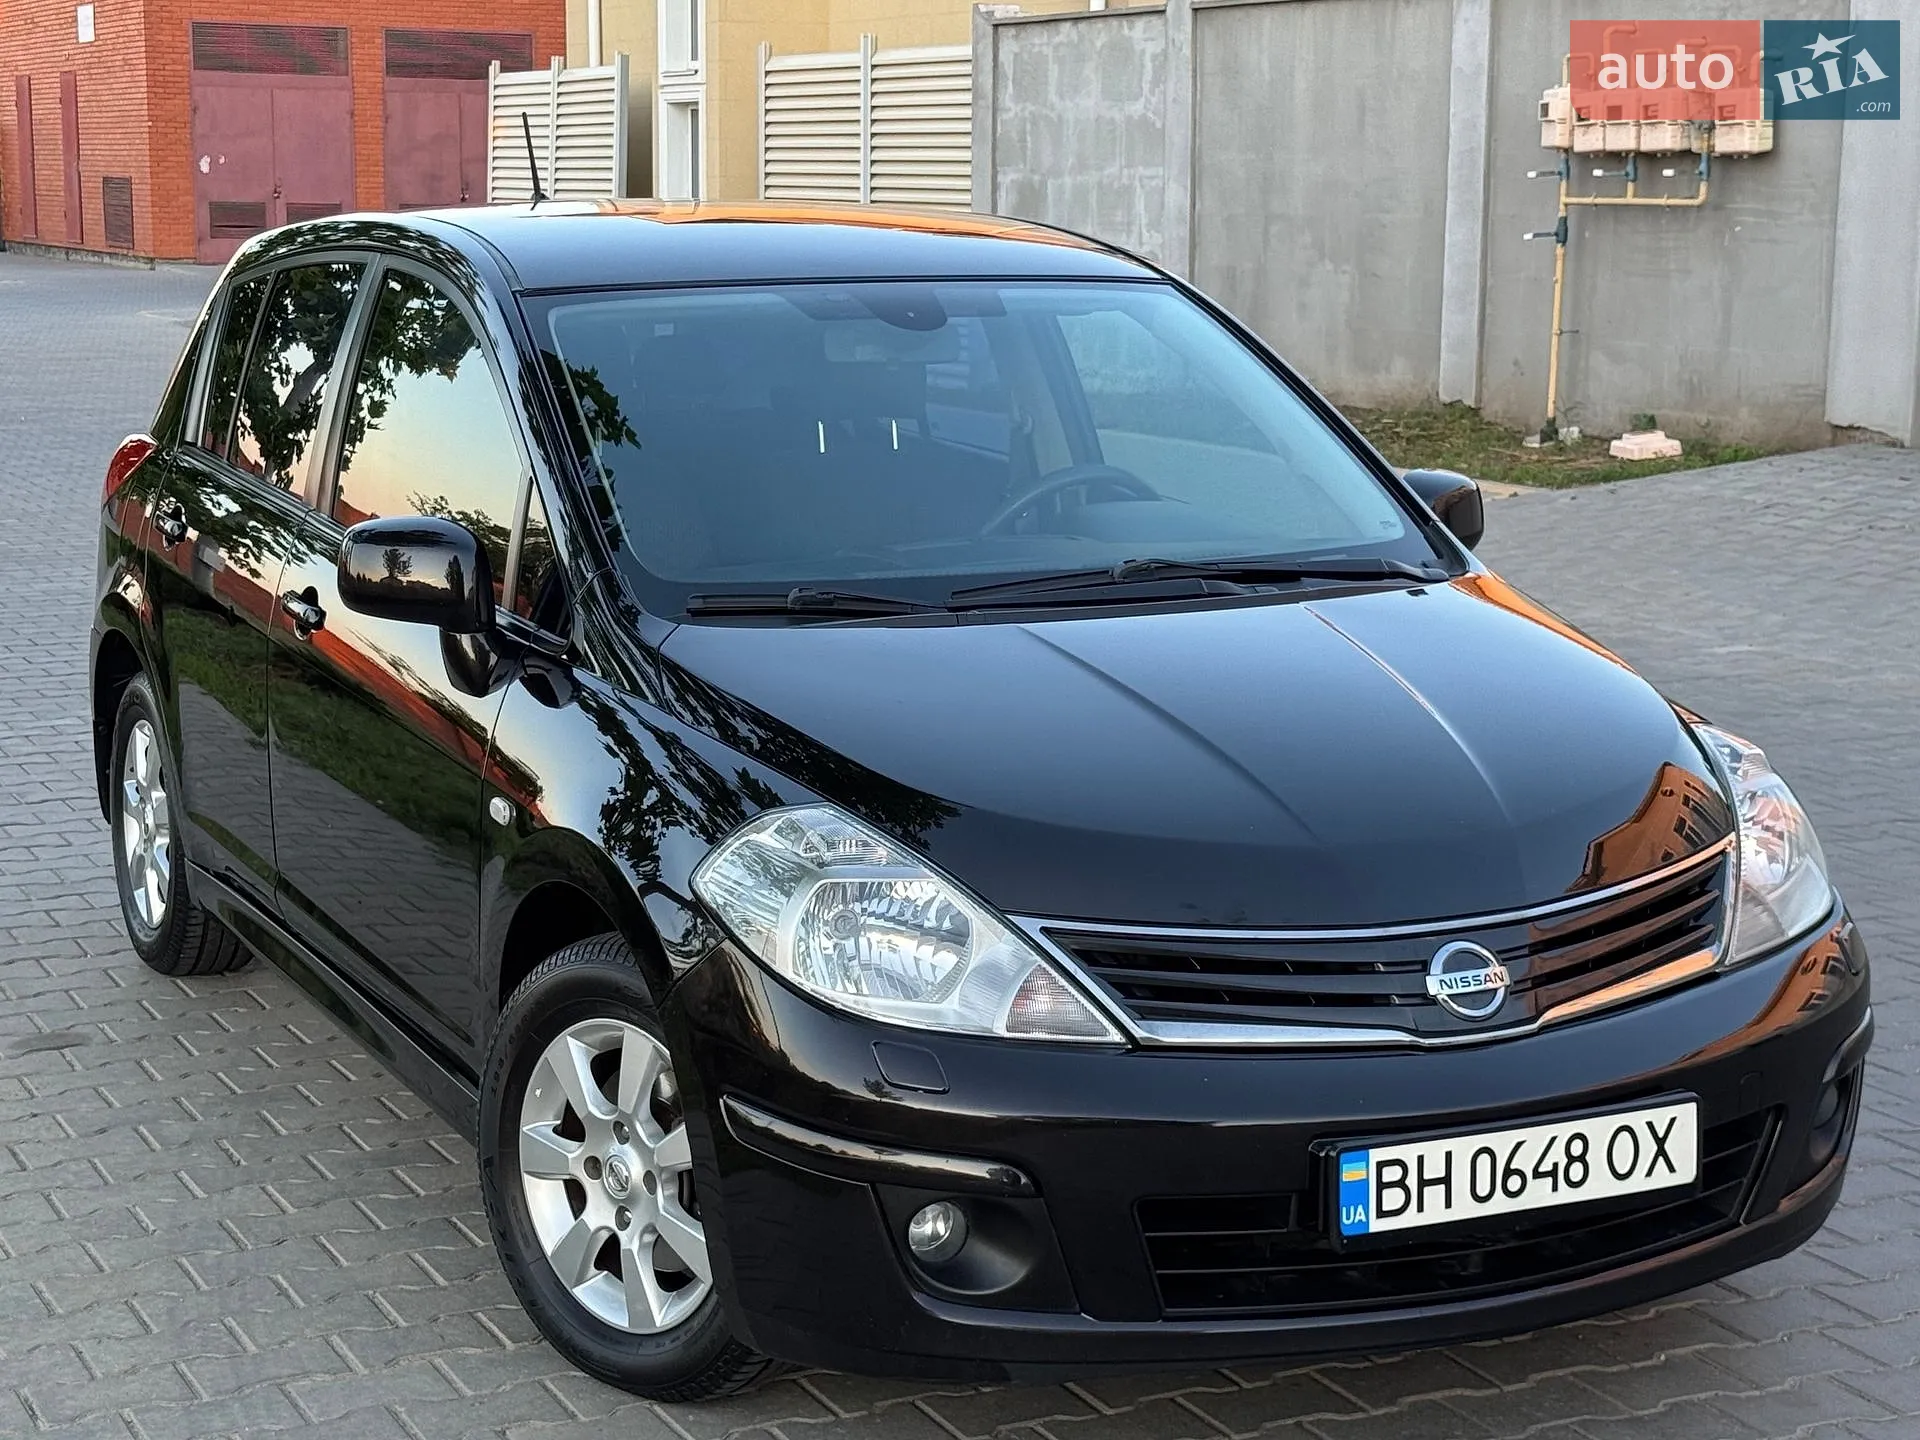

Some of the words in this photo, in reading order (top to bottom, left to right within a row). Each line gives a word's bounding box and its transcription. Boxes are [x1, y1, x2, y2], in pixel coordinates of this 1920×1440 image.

[1439, 970, 1505, 991] NISSAN
[1374, 1150, 1453, 1220] BH
[1469, 1132, 1590, 1204] 0648
[1606, 1116, 1678, 1182] OX
[1341, 1206, 1367, 1226] UA
